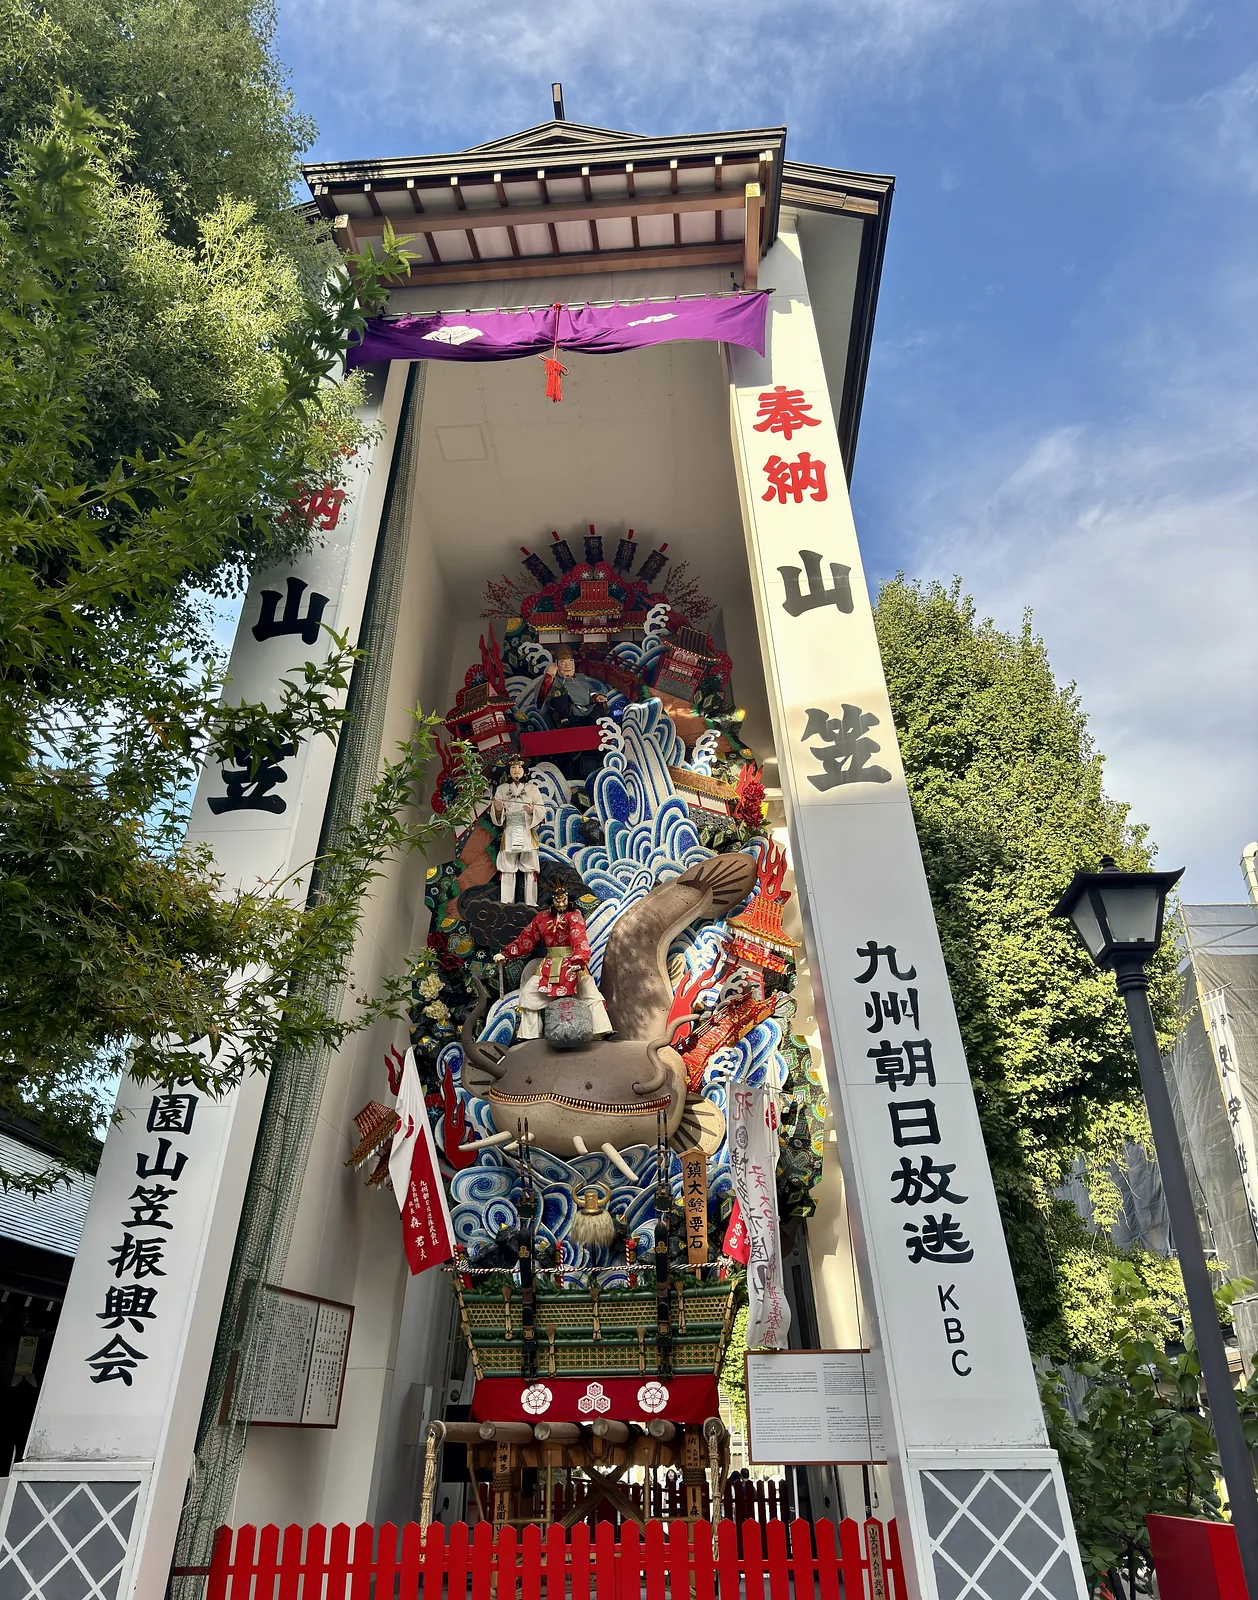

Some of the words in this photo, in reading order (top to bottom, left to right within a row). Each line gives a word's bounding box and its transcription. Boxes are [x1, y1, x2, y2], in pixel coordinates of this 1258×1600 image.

[753, 386, 828, 504] 奉納
[776, 550, 893, 793] 山笠
[84, 1058, 204, 1387] 園山笠振興会
[854, 940, 974, 1265] 九州朝日放送
[937, 1284, 972, 1377] KBC
